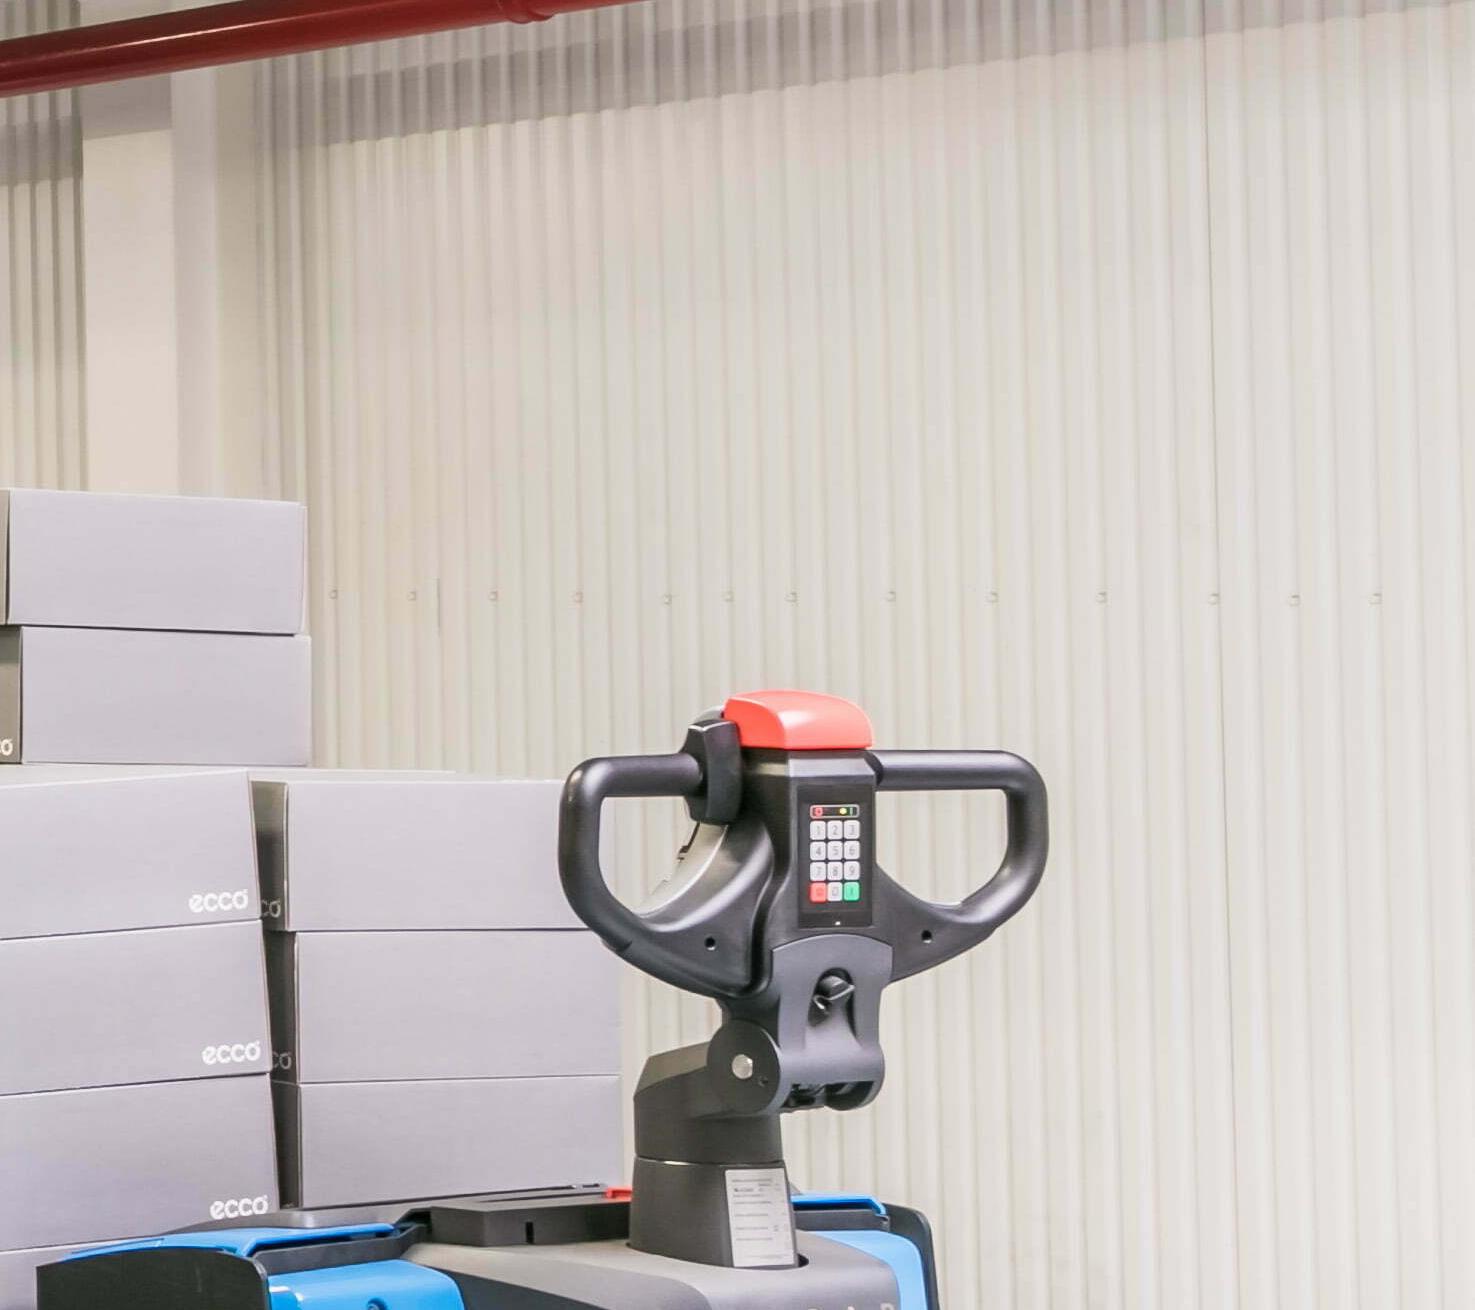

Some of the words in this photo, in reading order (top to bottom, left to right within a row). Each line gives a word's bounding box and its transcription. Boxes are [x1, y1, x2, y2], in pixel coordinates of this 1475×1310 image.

[188, 888, 249, 913] ecco
[201, 1040, 261, 1066] ecco
[209, 1194, 269, 1220] ecco
